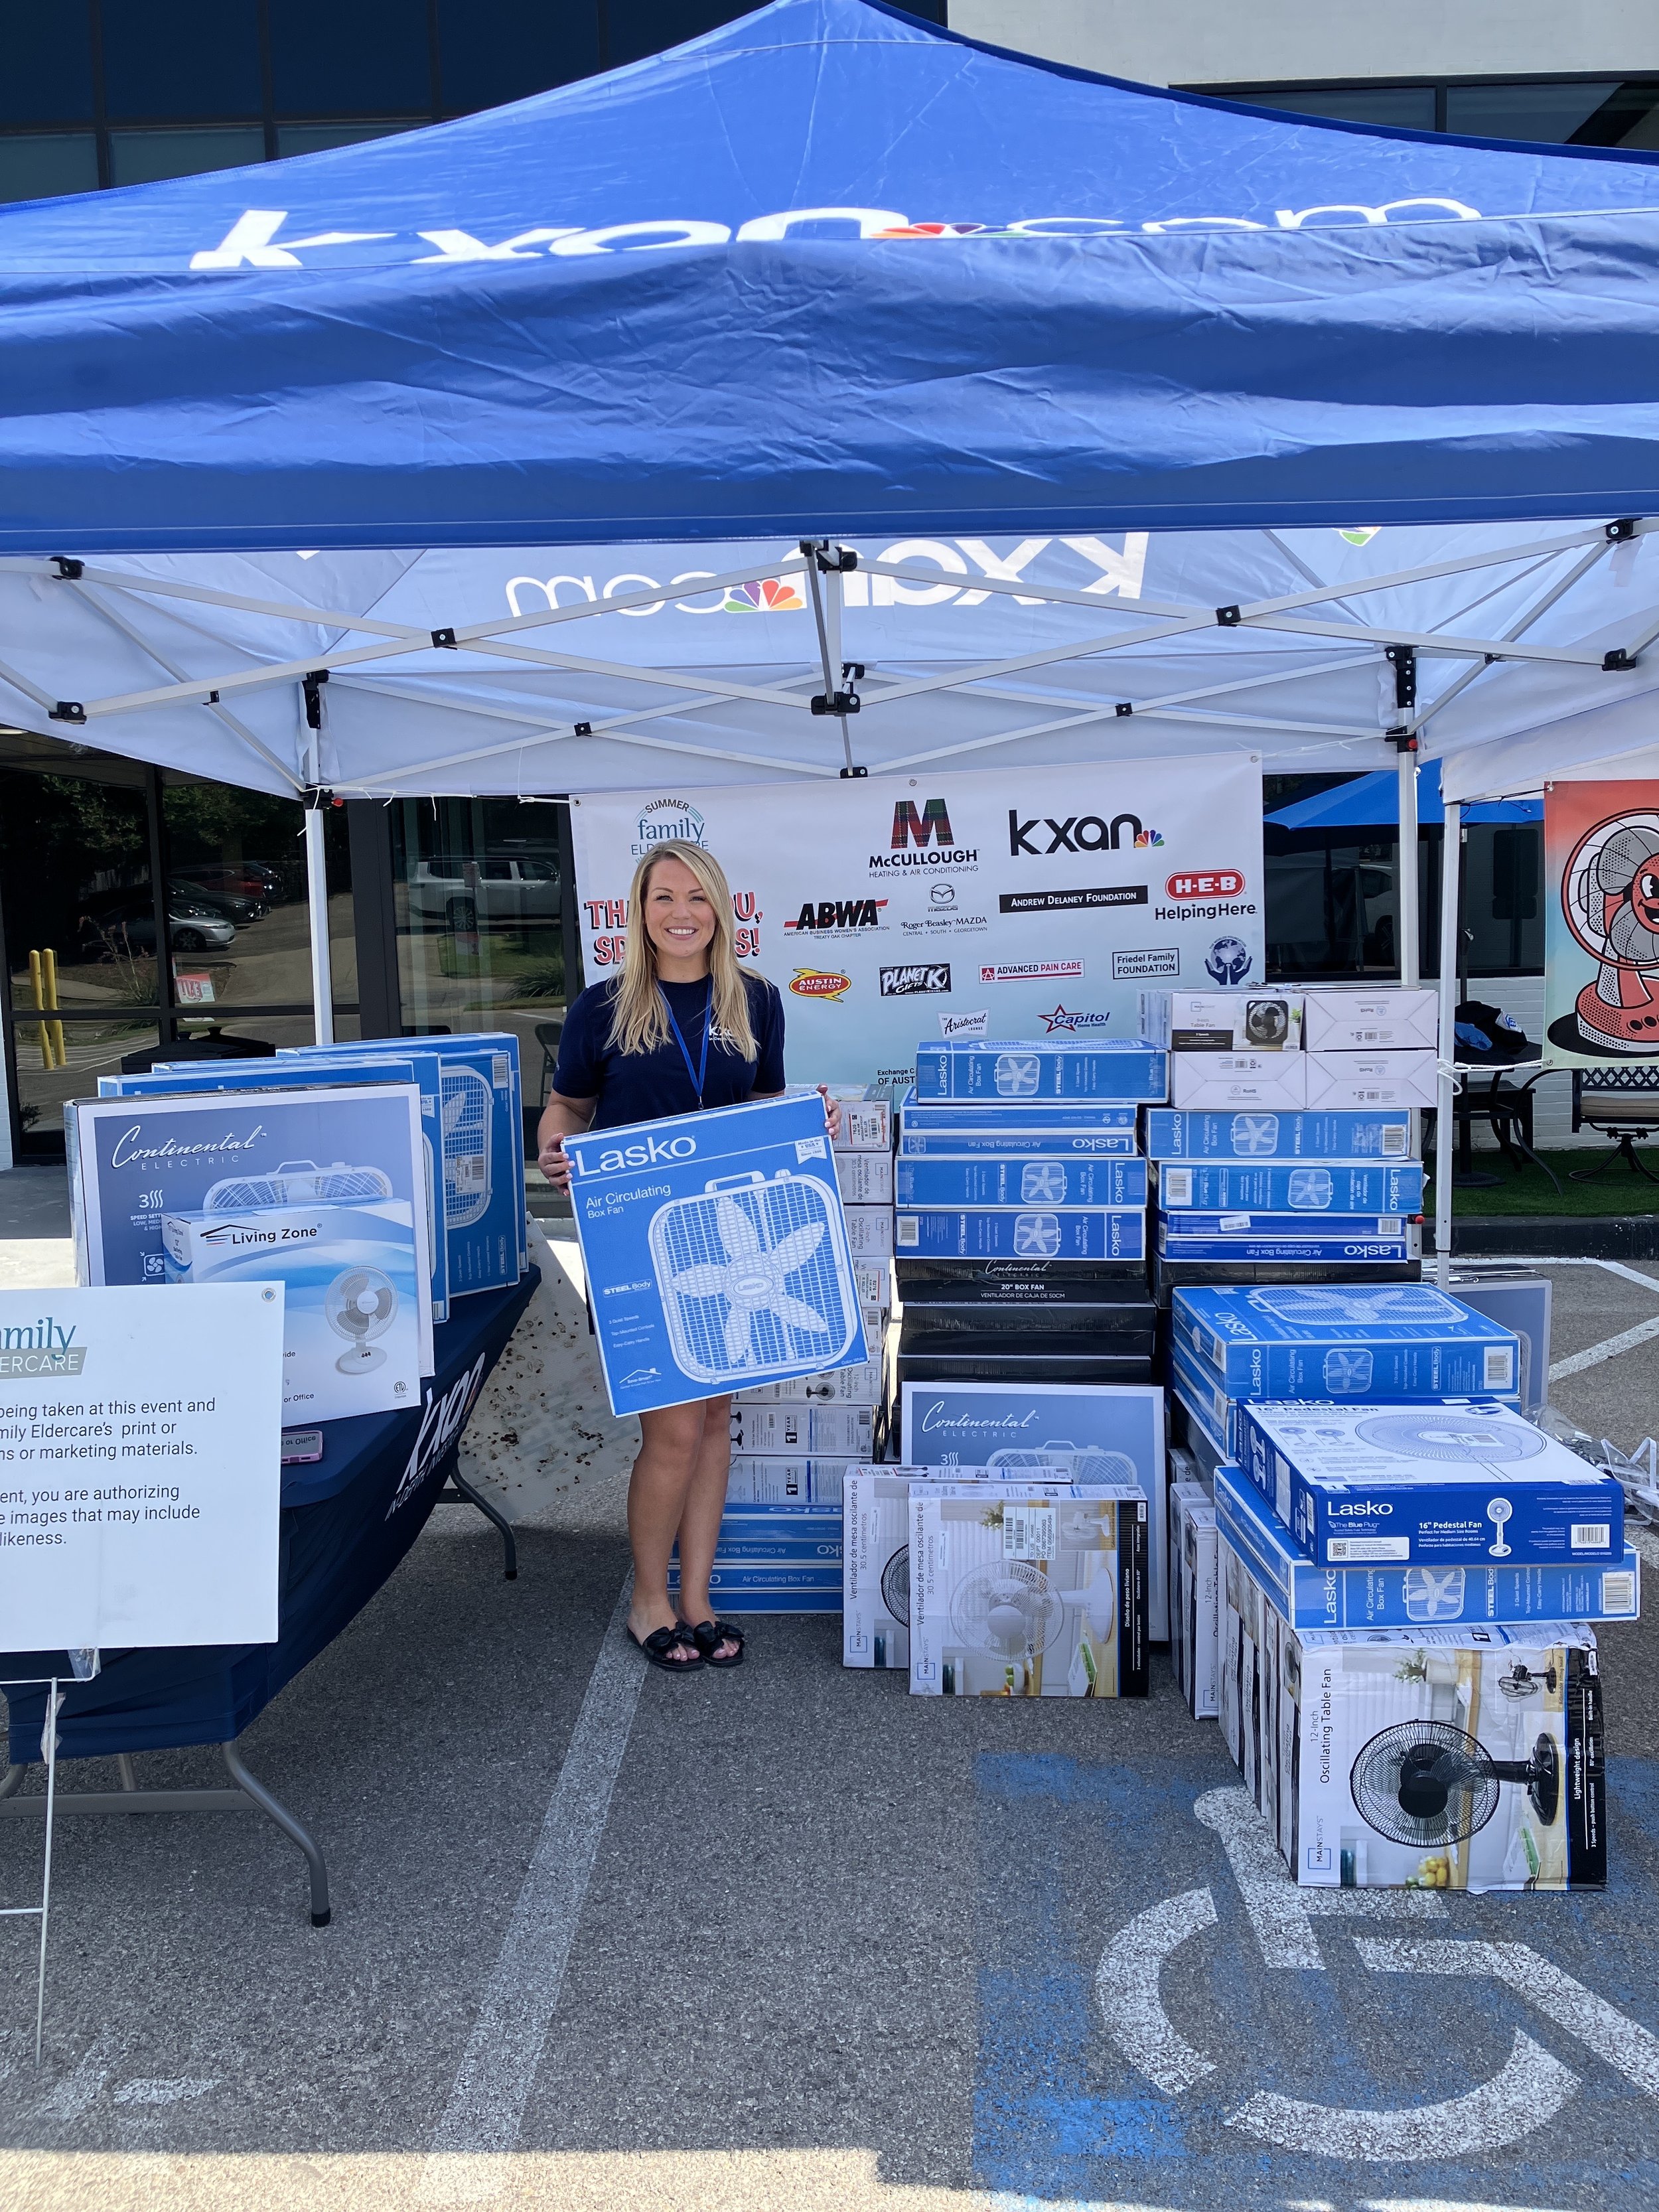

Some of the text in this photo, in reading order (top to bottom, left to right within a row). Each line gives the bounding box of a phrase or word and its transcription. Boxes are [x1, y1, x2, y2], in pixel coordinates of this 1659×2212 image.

[645, 798, 690, 814] SUMMER
[637, 818, 705, 844] family
[891, 798, 955, 849] M
[1008, 808, 1142, 857] kxan
[869, 849, 978, 868] McCULLOUGH
[923, 865, 979, 874] CONDITIONING
[796, 899, 879, 930] ABWA
[901, 916, 987, 930] Roger Beasley MAZDA
[1117, 952, 1175, 964] Friedel Family
[997, 962, 1082, 975] ADVANCED PAIN CARE
[1117, 963, 1175, 975] FOUNDATION
[798, 978, 842, 986] AUSTIN
[881, 966, 949, 995] PLANET K
[896, 981, 923, 994] GIFTS
[944, 1013, 987, 1035] Aristocrat
[1054, 1011, 1111, 1025] Capitol
[892, 1076, 916, 1084] AUST
[937, 1055, 948, 1096] Lasko
[1171, 1114, 1182, 1155] Lasko
[111, 1125, 261, 1169] Continental
[1072, 1138, 1129, 1151] Lasko
[141, 1155, 240, 1171] ELECTRIC
[575, 1136, 697, 1177] Lasko
[1115, 1162, 1125, 1203] Lasko
[1390, 1169, 1401, 1211] Lasko
[585, 1183, 672, 1209] Air Circulating
[587, 1204, 624, 1218] Box Fan
[232, 1226, 318, 1245] Living Zone
[1111, 1215, 1121, 1256] Lasko
[1344, 1244, 1402, 1258] Lasko
[985, 1259, 1047, 1274] Continental
[604, 1281, 651, 1295] STEEL Body
[0, 1317, 76, 1361] mily
[0, 1354, 79, 1373] ERCARE
[1250, 1349, 1262, 1396] Lasko
[293, 1392, 315, 1402] Office
[42, 1402, 84, 1417] taken
[89, 1403, 104, 1415] at
[108, 1400, 136, 1414] this
[141, 1400, 182, 1414] event
[187, 1397, 216, 1412] and
[922, 1400, 1035, 1434] Continental
[0, 1424, 27, 1442] mily
[121, 1422, 157, 1439] print
[161, 1423, 177, 1434] or
[943, 1430, 1017, 1438] ELECTRIC
[19, 1449, 35, 1459] or
[40, 1443, 117, 1460] marketing
[121, 1440, 198, 1457] materials.
[0, 1484, 180, 1506] ent, you are authorizing
[10, 1510, 67, 1527] images
[72, 1507, 102, 1522] that
[108, 1509, 140, 1524] may
[144, 1504, 200, 1520] include
[916, 1502, 924, 1511] de
[1327, 1500, 1394, 1516] Lasko
[0, 1531, 66, 1546] likeness.
[916, 1572, 924, 1582] de
[1310, 1710, 1319, 1742] 12-Inch
[1320, 1668, 1333, 1783] Oscillating Table Fan
